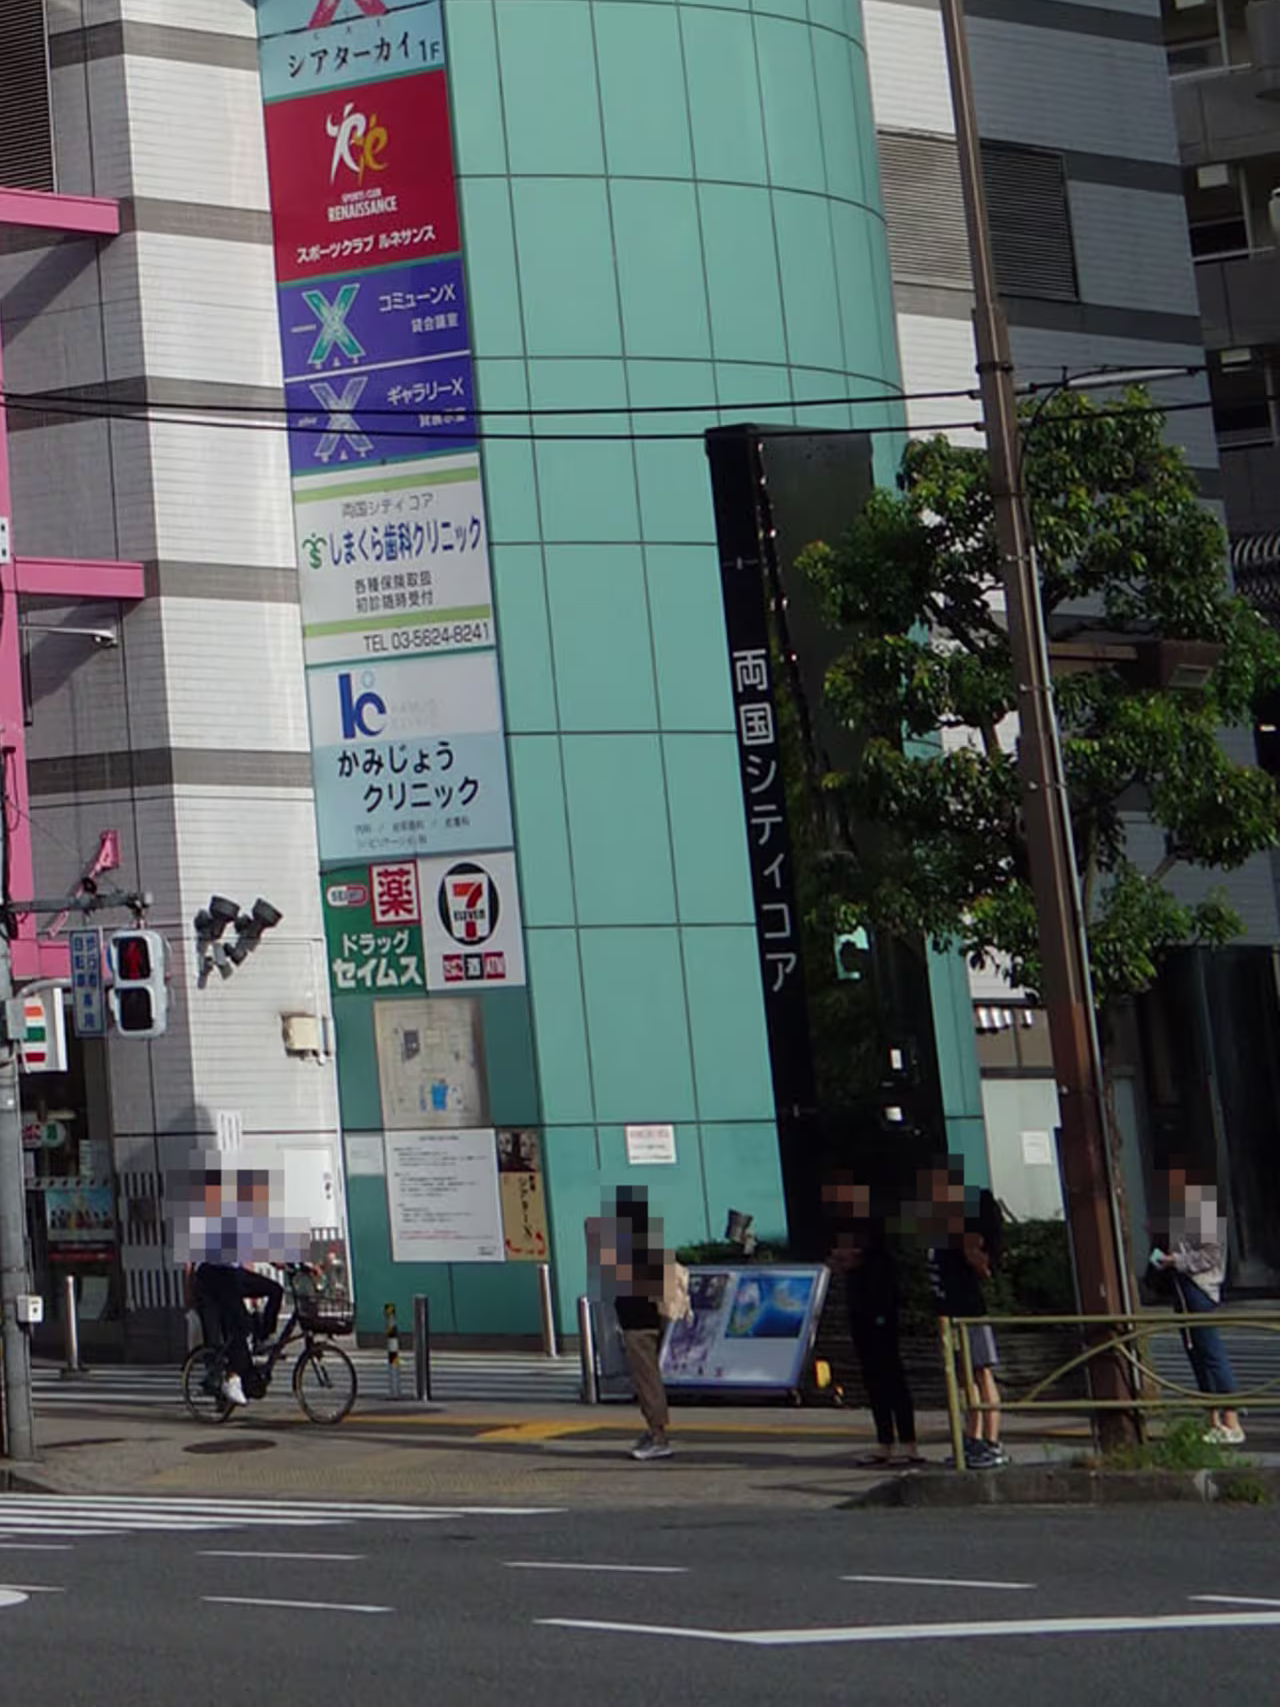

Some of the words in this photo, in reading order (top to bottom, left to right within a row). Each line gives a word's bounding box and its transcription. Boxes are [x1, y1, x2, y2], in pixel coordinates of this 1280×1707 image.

[289, 32, 409, 78] シアターカイ
[419, 39, 440, 62] 1F
[328, 195, 398, 222] RENAISSANCE
[297, 235, 375, 264] スポーツクラブ
[379, 225, 436, 250] ルネサンス
[378, 283, 457, 313] コミューンX
[387, 377, 465, 406] ギャラリーX
[342, 492, 434, 518] 両国シティコア
[329, 514, 482, 567] しまくら歯科クリニック
[355, 570, 432, 595] 各種保険取扱
[356, 589, 434, 614] 初診随時受付
[363, 634, 389, 653] TEL
[337, 741, 454, 778] かみじょう
[363, 776, 480, 813] クリニック
[733, 648, 797, 992] 両国シティコア
[376, 867, 414, 918] 薬
[342, 929, 410, 957] ドラッグ
[332, 956, 423, 988] セイムス
